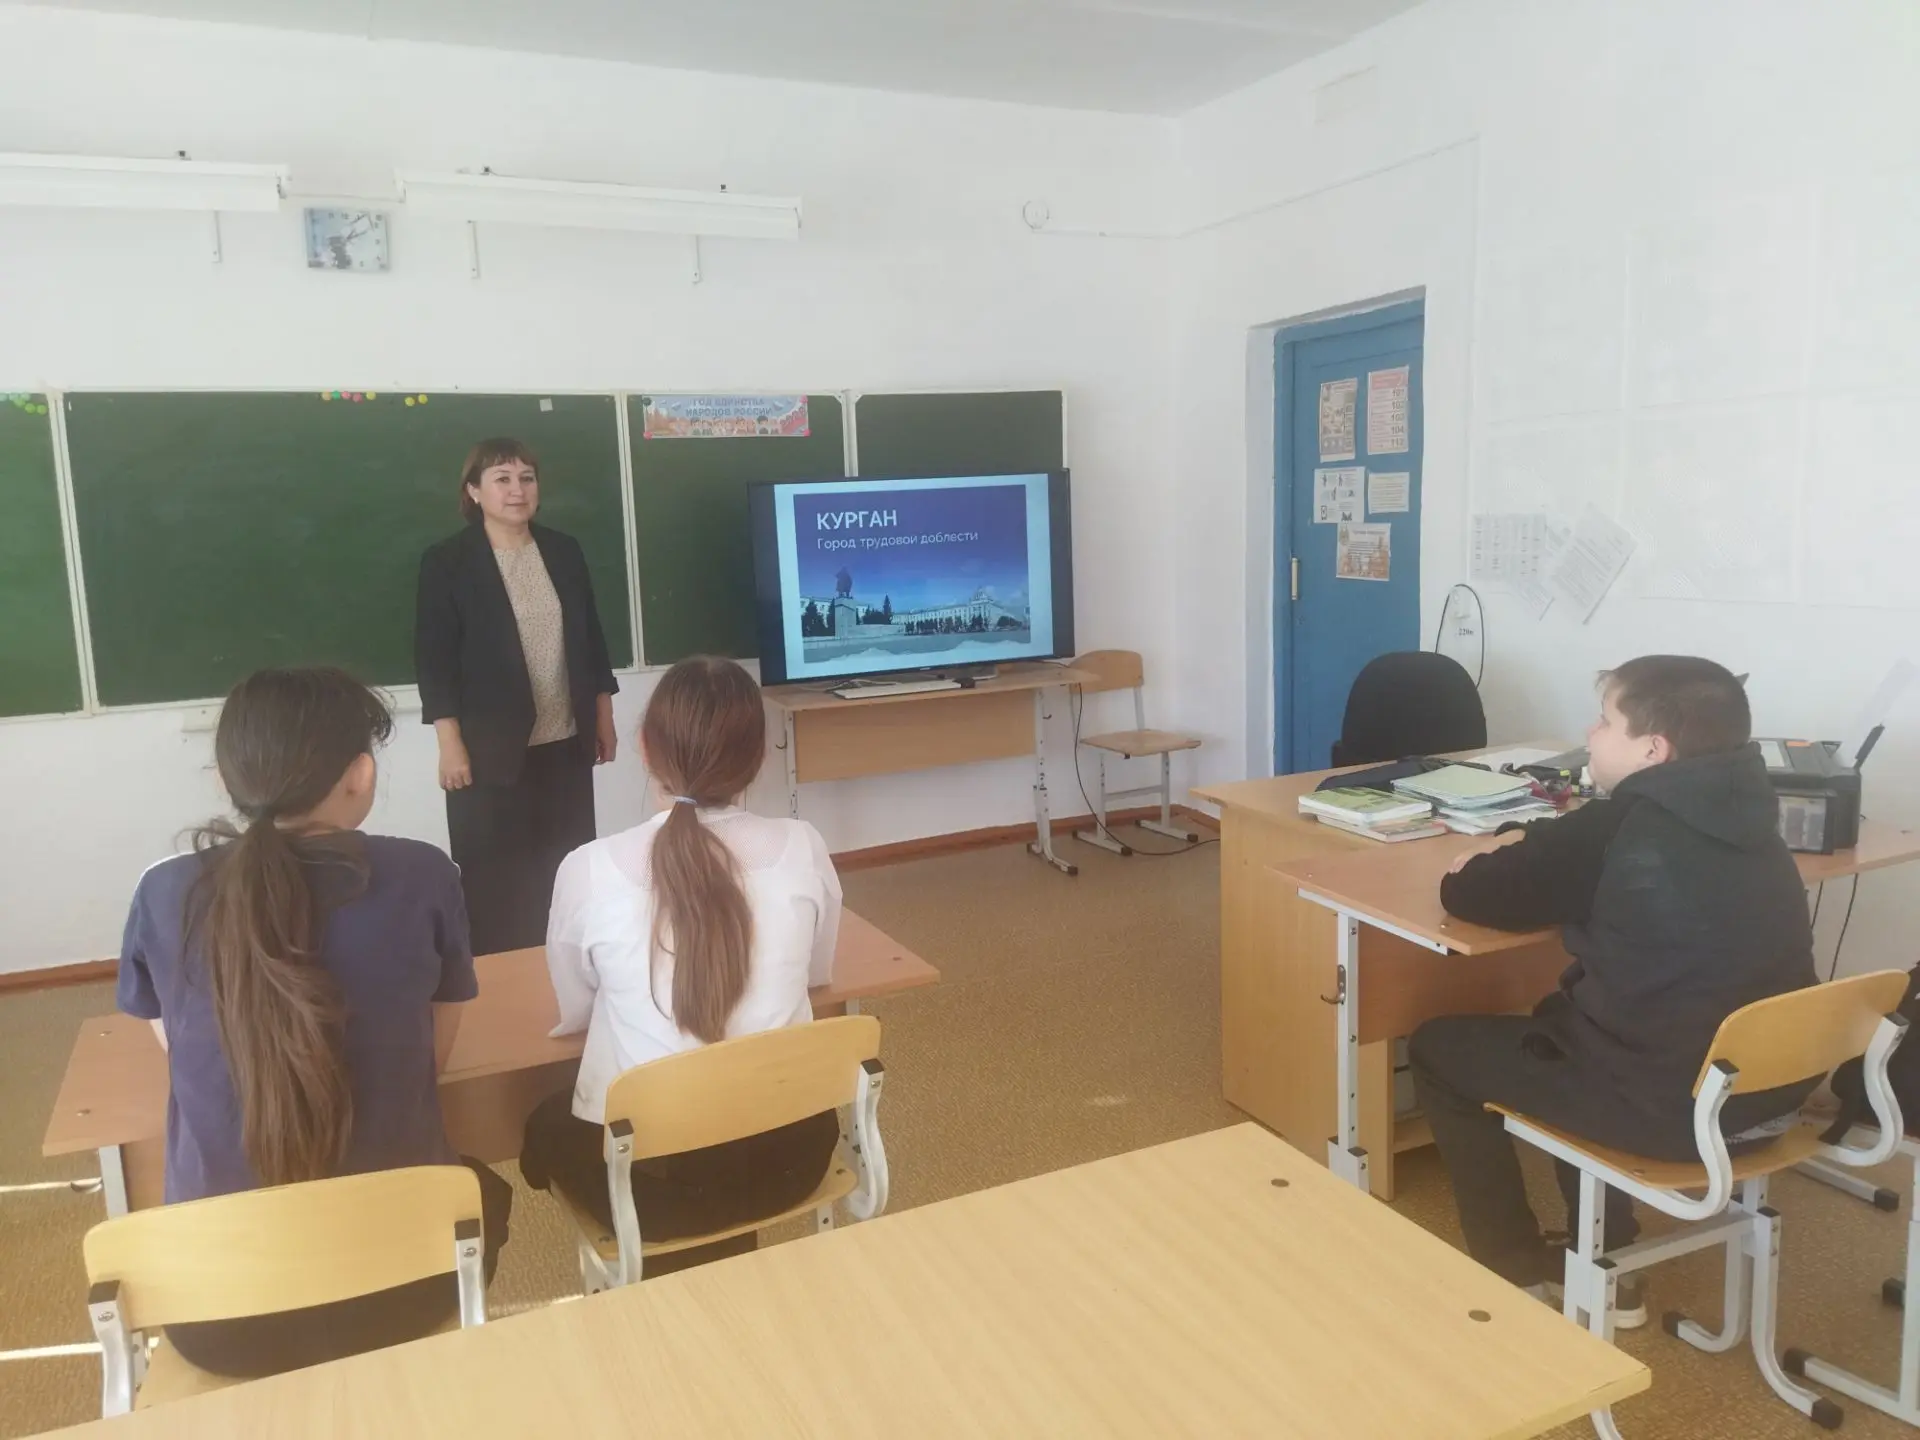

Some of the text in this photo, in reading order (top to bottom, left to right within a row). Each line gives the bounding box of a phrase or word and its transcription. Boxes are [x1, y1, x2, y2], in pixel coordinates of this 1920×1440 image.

[686, 407, 772, 417] НАРОДОВ РОССИИ
[816, 509, 898, 531] КУРГАН
[817, 537, 856, 551] Город
[920, 530, 979, 545] доблести
